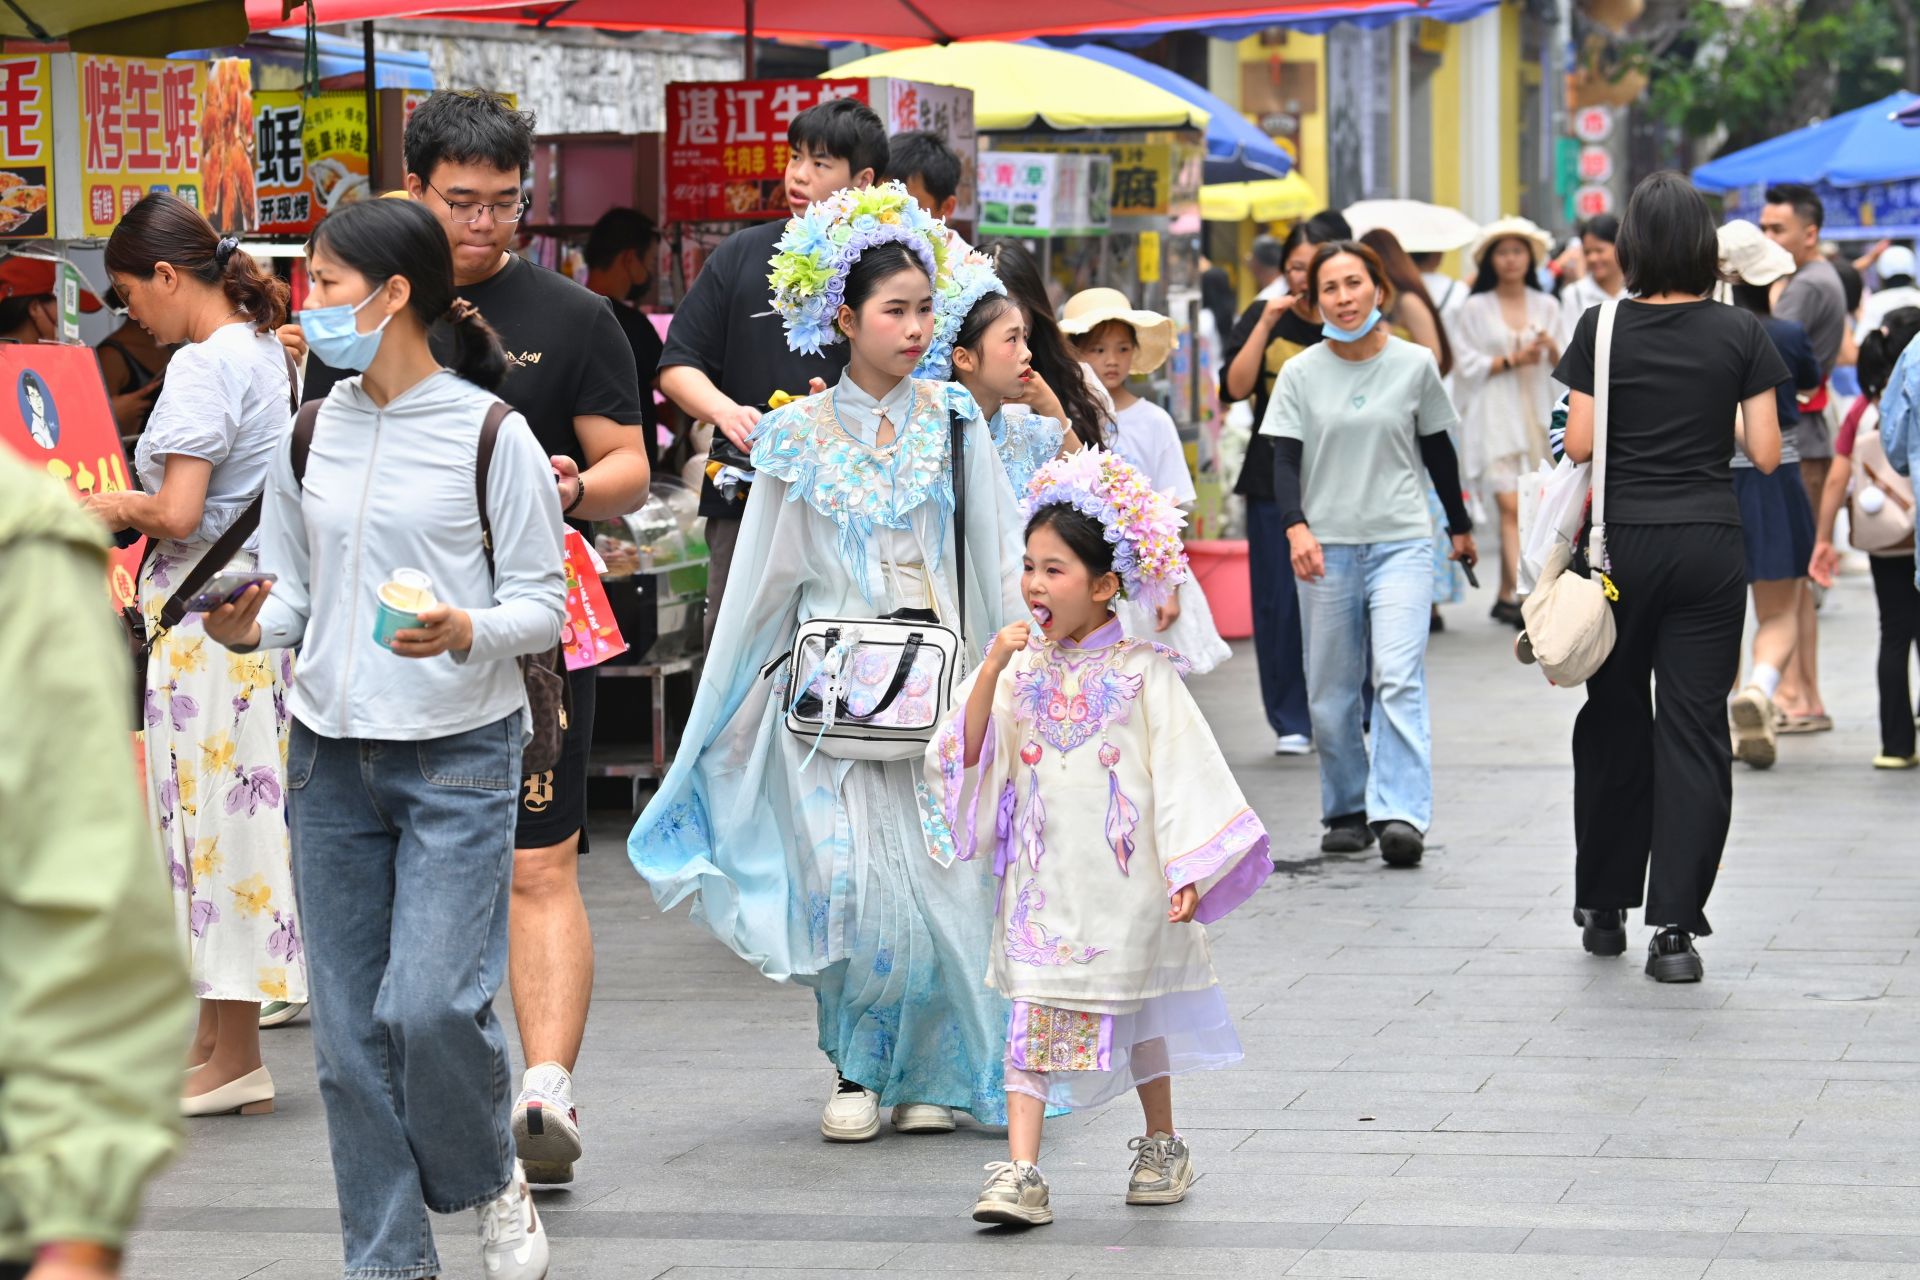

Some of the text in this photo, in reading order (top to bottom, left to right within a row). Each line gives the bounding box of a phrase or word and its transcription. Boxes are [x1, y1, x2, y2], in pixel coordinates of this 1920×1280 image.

[84, 60, 198, 172] 烤生蚝
[258, 107, 301, 184] 蚝
[723, 146, 766, 176] 牛肉串
